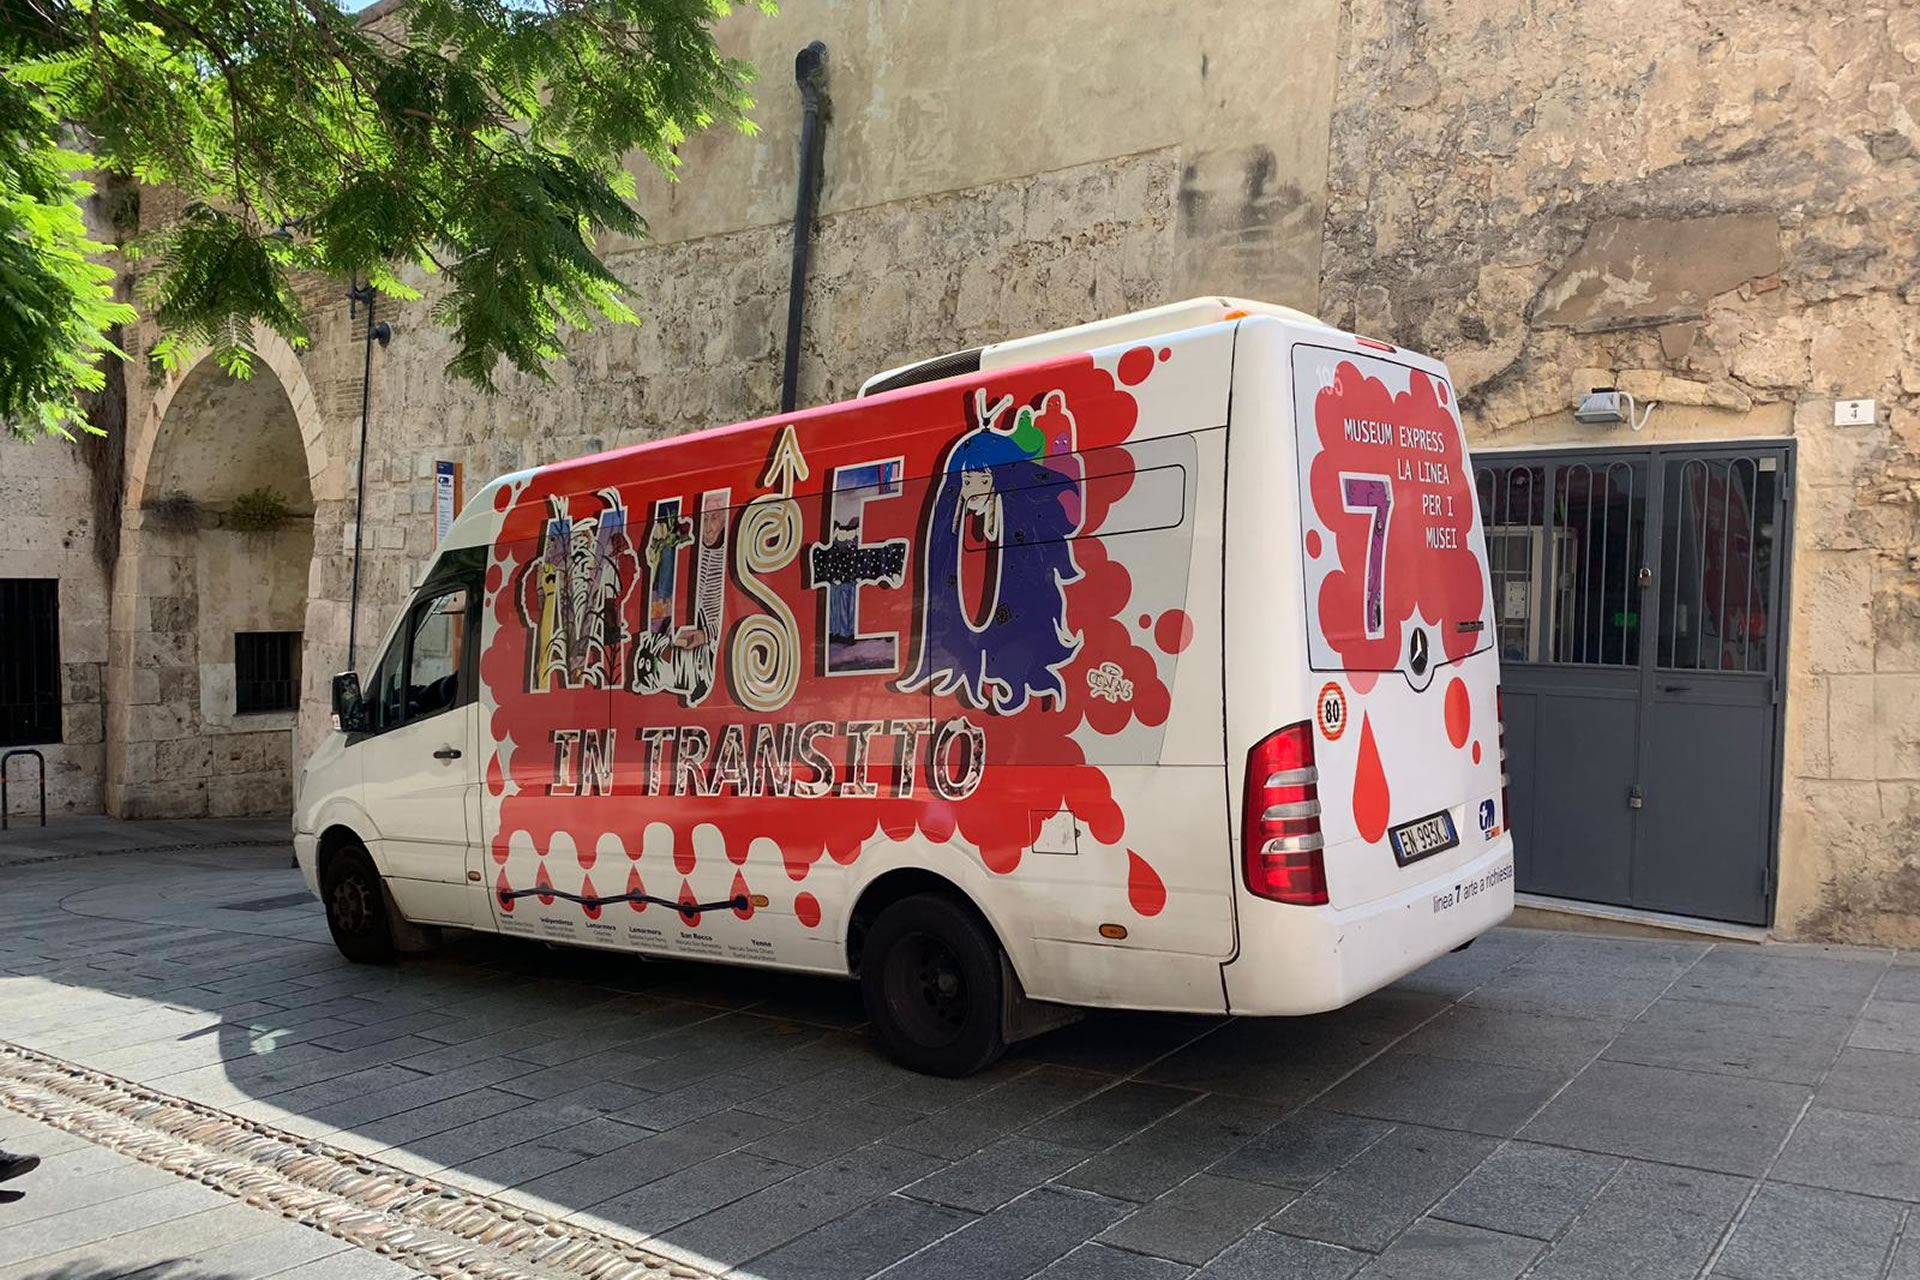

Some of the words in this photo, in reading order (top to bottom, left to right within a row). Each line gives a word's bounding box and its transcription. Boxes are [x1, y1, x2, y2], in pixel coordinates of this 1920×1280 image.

[1343, 418, 1393, 445] MUSEUM
[1400, 425, 1445, 452] EXPRESS
[1398, 458, 1412, 481] LA
[1418, 462, 1450, 485] LINEA
[1422, 494, 1442, 516] PER
[1447, 495, 1454, 517] I
[522, 389, 1086, 715] MUSEO
[1425, 527, 1458, 549] MUSEI
[1338, 471, 1395, 640] 7
[1325, 699, 1340, 723] 80
[549, 727, 617, 796] IN
[641, 716, 986, 800] TRANSITO
[1399, 829, 1418, 856] EN
[1433, 893, 1454, 914] linea
[1455, 884, 1461, 903] 7
[1463, 881, 1478, 900] arte
[1479, 878, 1485, 892] a
[1486, 864, 1513, 889] richiesta
